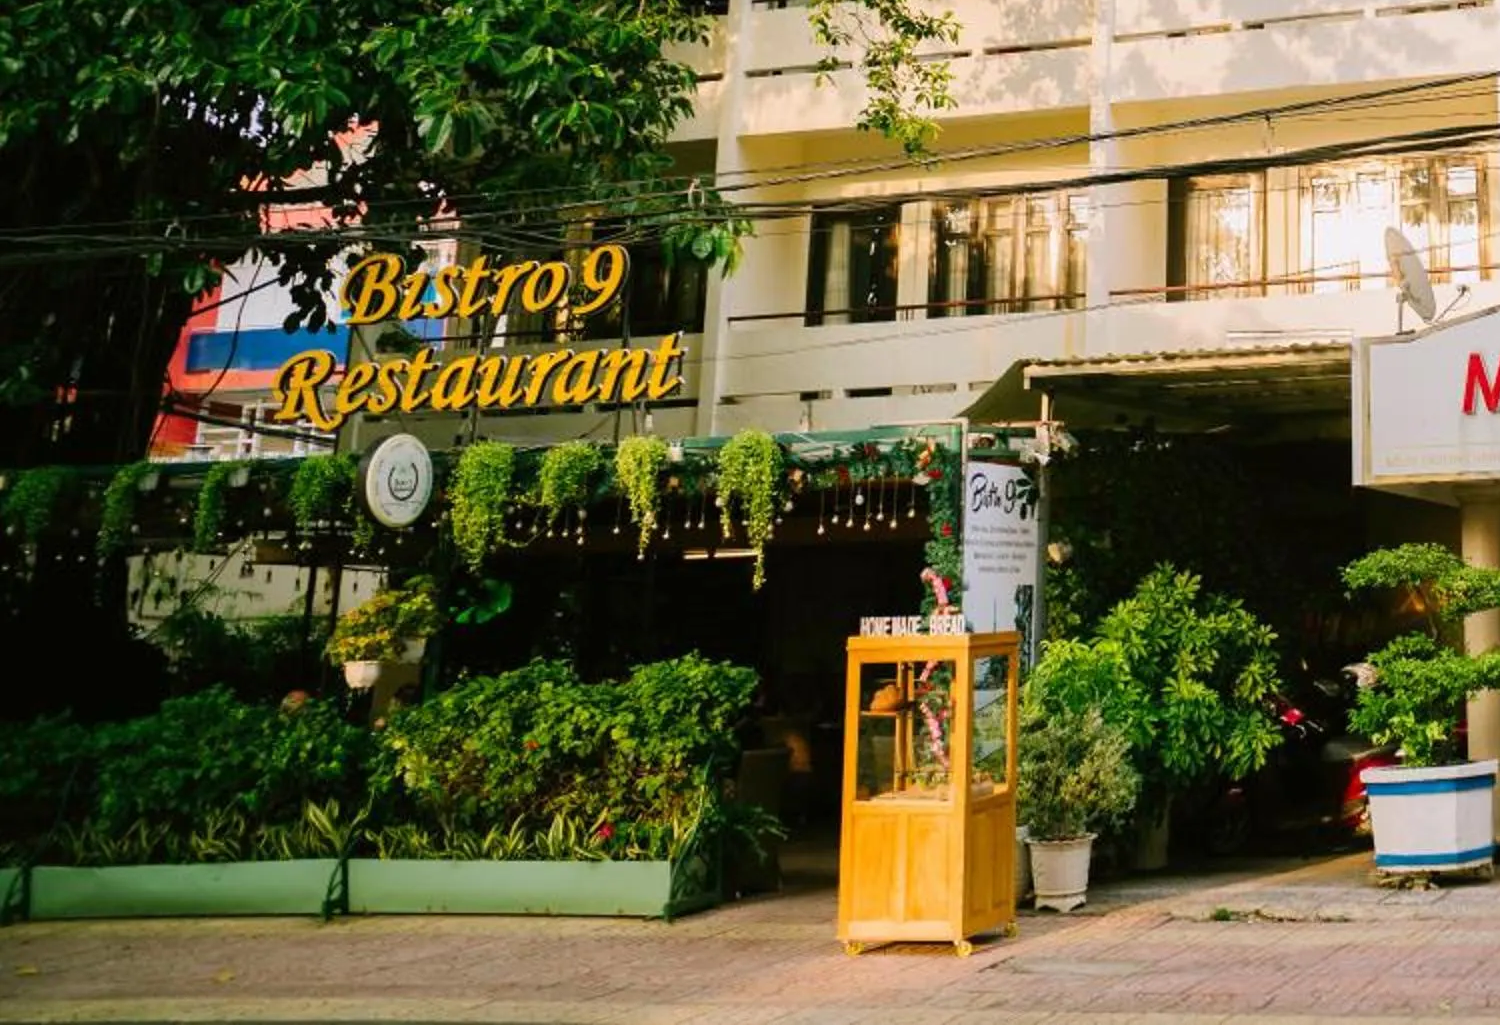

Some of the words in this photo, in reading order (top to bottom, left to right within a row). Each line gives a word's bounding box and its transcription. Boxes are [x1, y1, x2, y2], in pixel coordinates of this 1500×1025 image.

[341, 252, 569, 325] Bistro
[571, 244, 630, 315] 9
[273, 332, 686, 432] Restaurant
